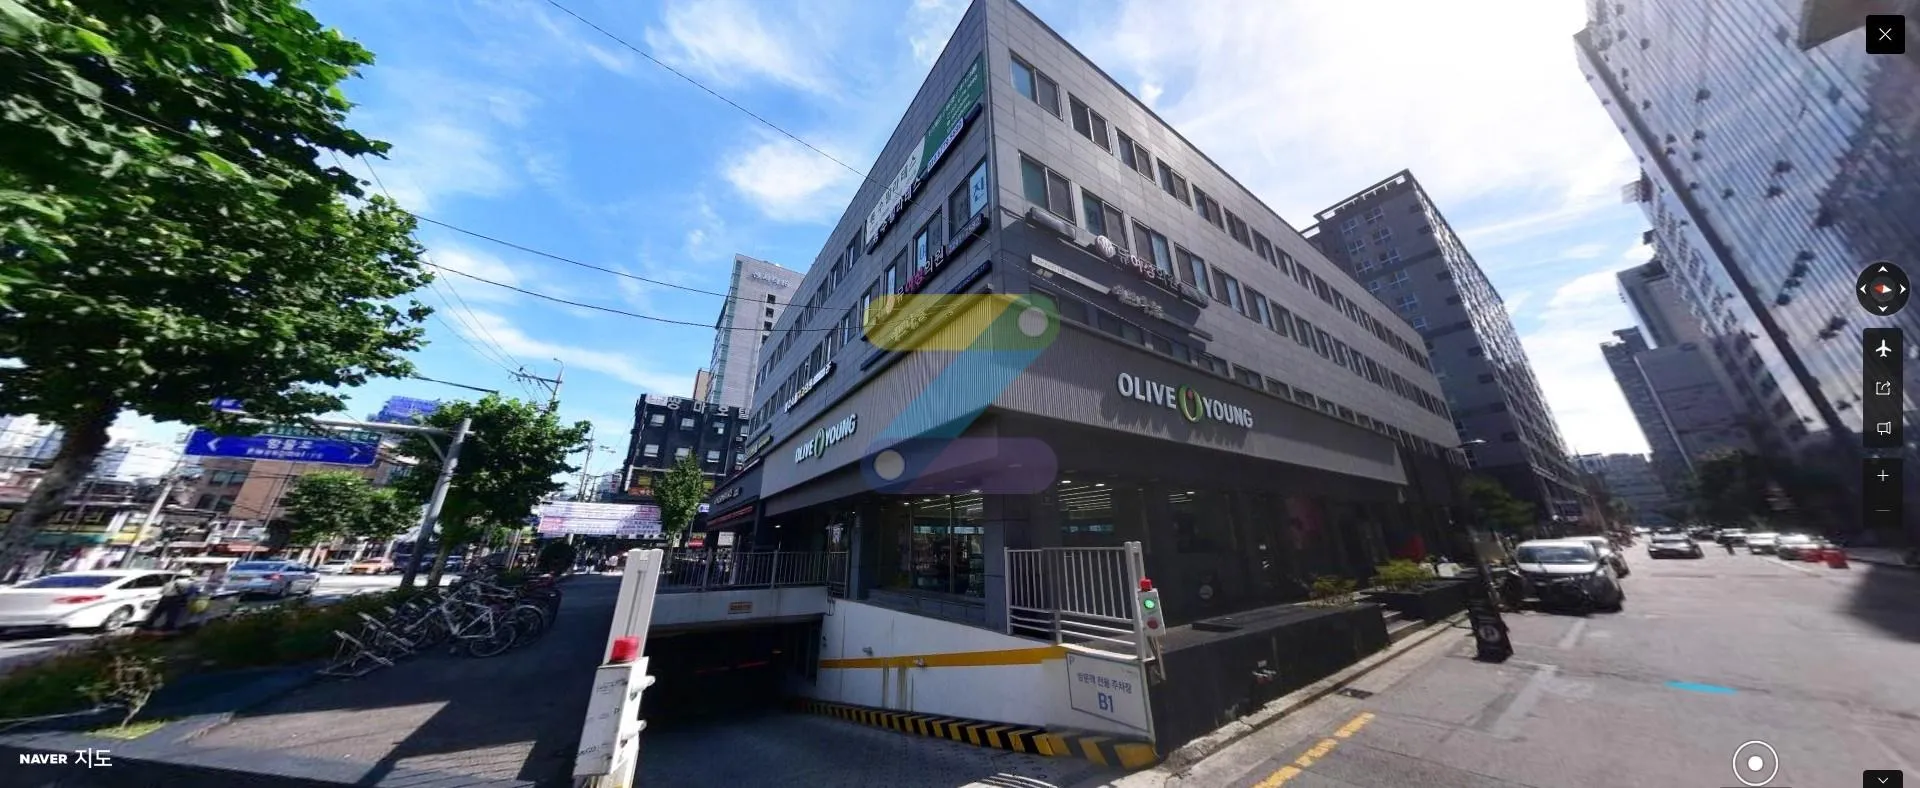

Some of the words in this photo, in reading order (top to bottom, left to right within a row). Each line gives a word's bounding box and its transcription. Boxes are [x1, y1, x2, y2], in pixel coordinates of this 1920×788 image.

[1117, 372, 1177, 410] OLIVE
[1202, 396, 1254, 428] YOUNG
[795, 440, 815, 464] OLIVE
[825, 413, 858, 445] YOUNG
[1098, 692, 1114, 713] B1
[1111, 679, 1133, 694] 주차장
